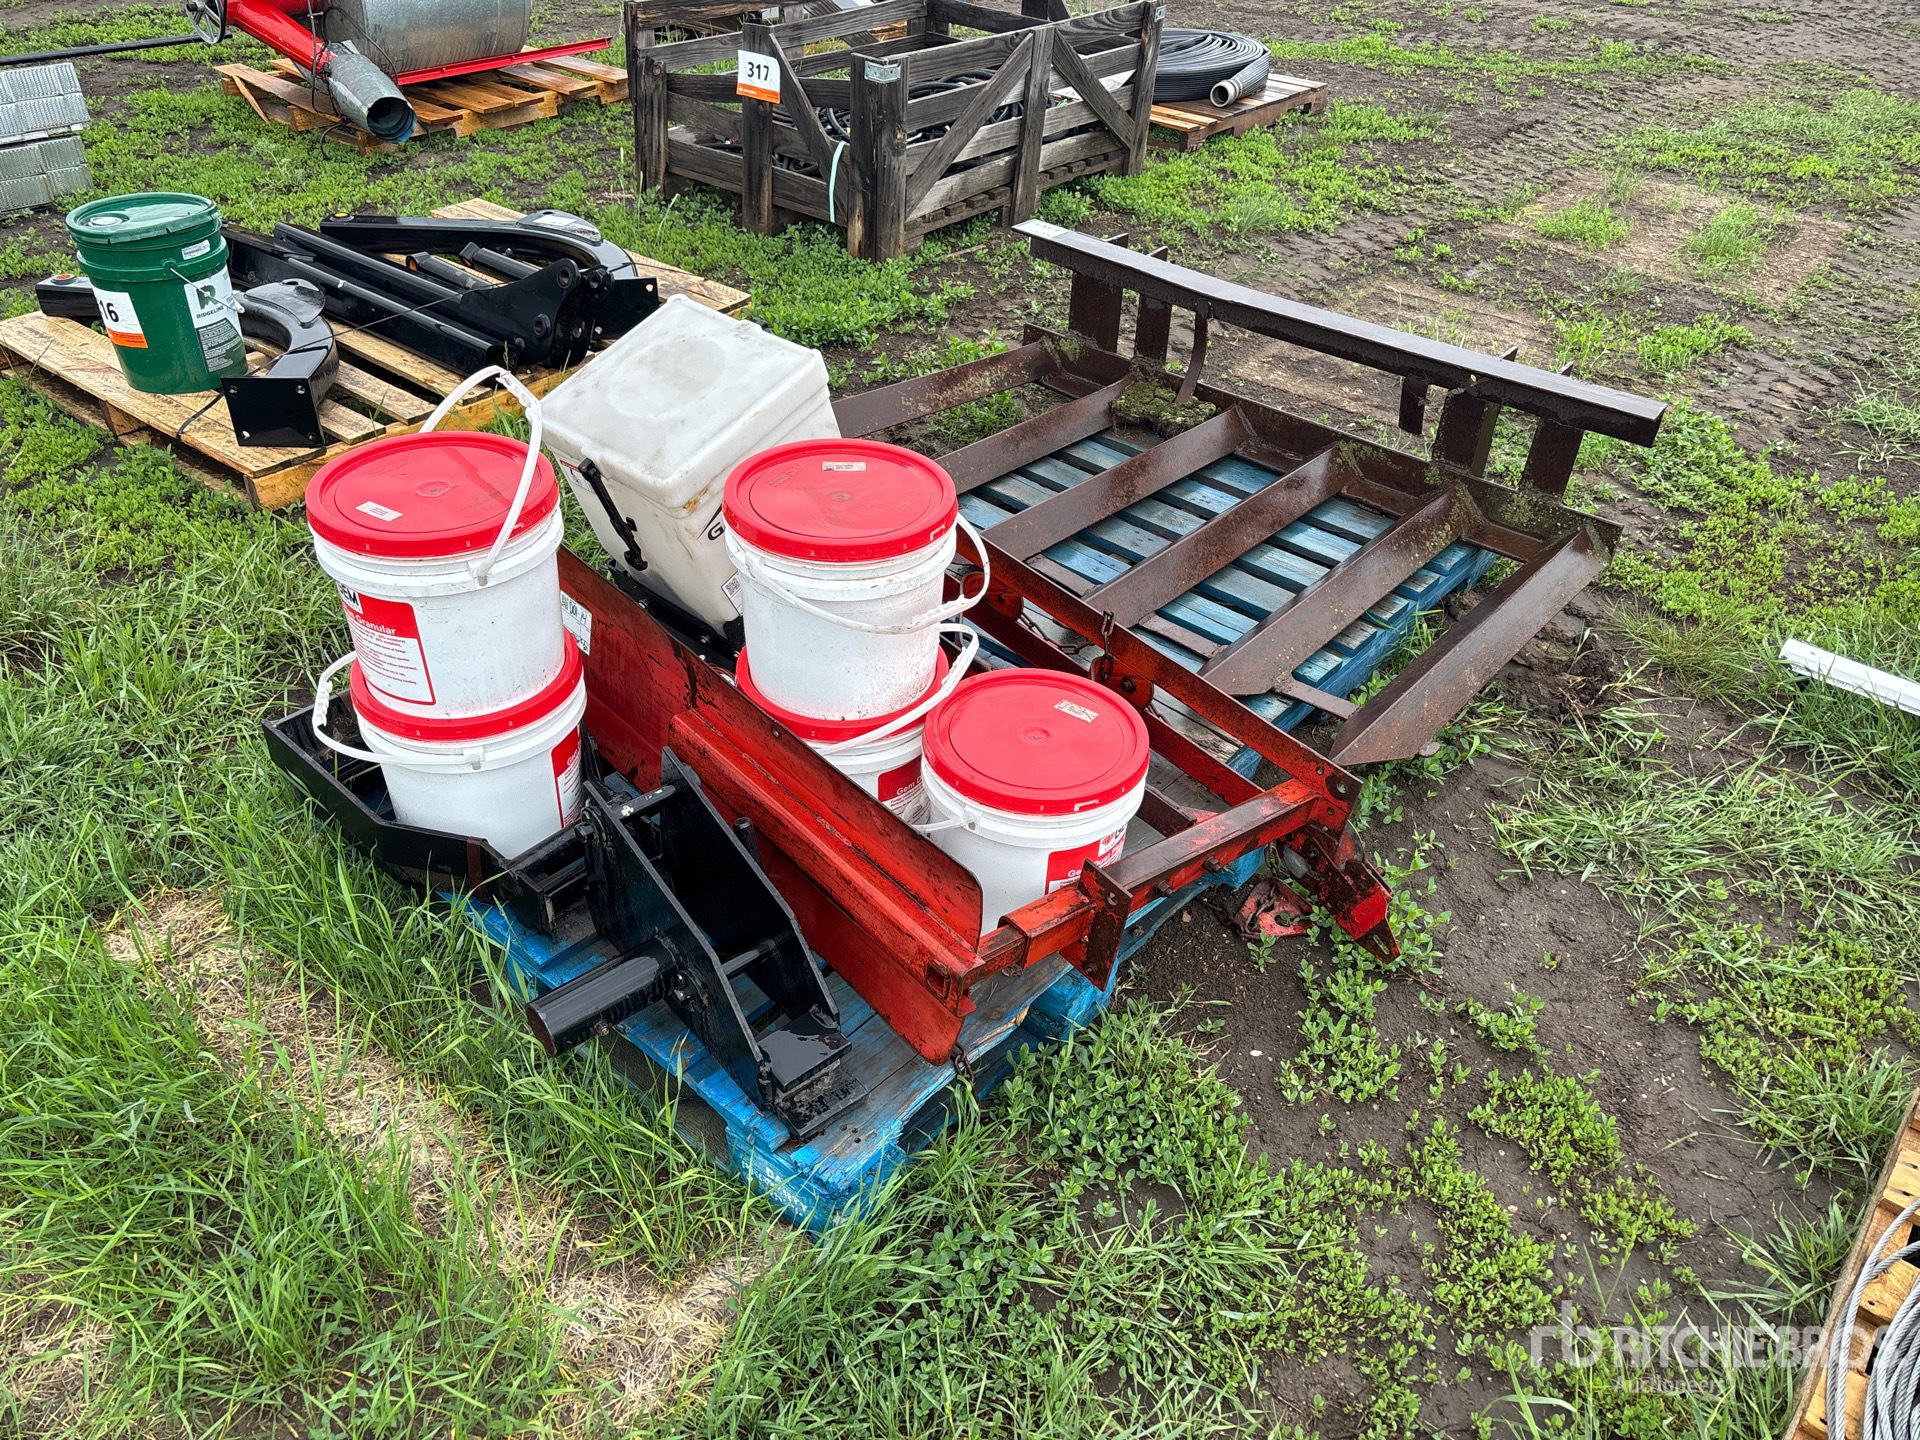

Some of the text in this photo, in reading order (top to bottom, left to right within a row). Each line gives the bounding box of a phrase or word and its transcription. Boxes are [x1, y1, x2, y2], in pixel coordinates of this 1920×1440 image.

[747, 61, 770, 81] 317
[196, 304, 225, 320] RIDGELINE
[355, 613, 397, 636] Granular
[896, 781, 915, 796] Gem
[1067, 869, 1082, 878] Ge
